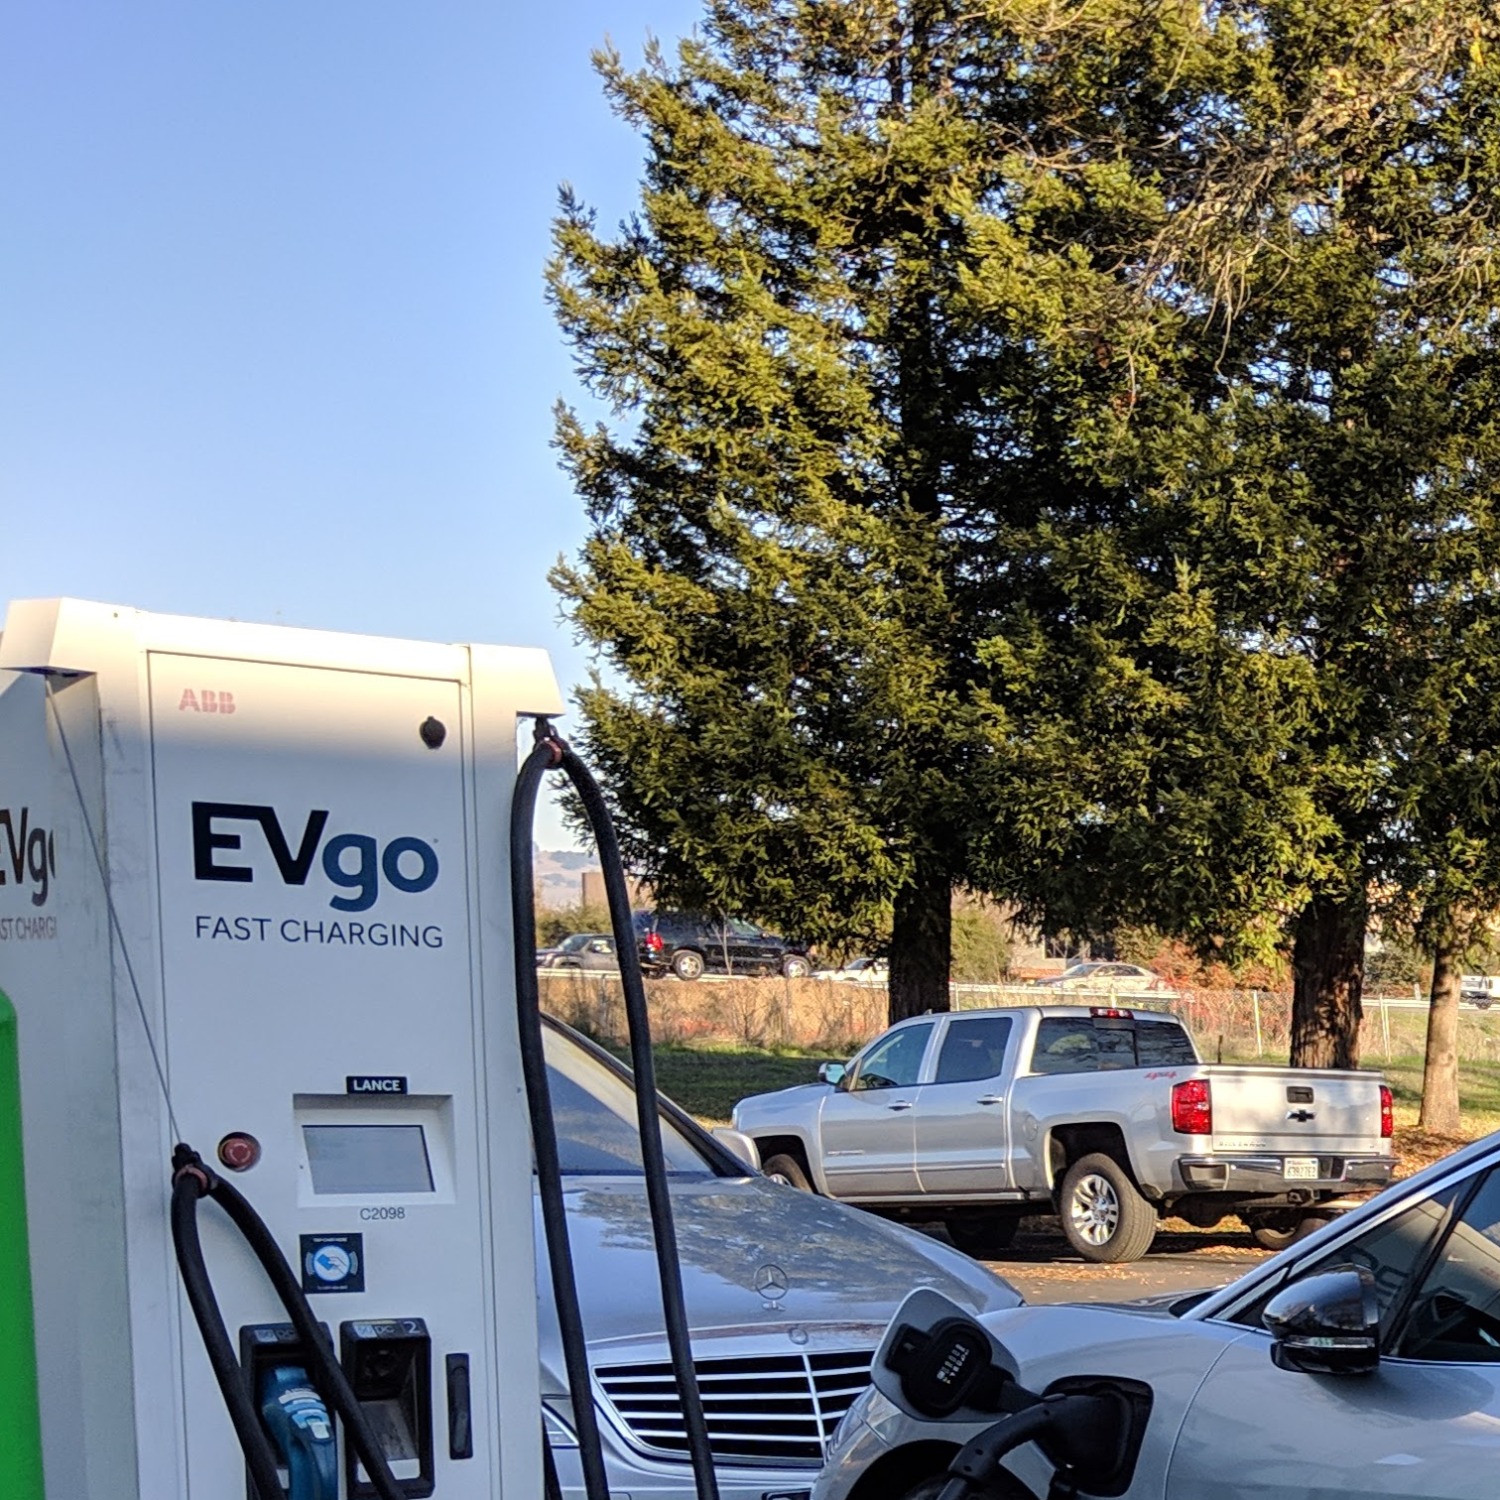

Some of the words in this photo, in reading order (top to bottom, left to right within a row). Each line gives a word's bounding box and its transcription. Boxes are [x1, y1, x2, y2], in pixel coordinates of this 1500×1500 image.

[178, 688, 236, 715] ABB
[191, 801, 439, 913] EVgo
[195, 915, 272, 941] FAST
[280, 918, 443, 949] CHARGING
[353, 1079, 402, 1092] LANCE
[360, 1207, 406, 1221] C2098
[403, 1320, 421, 1334] 2
